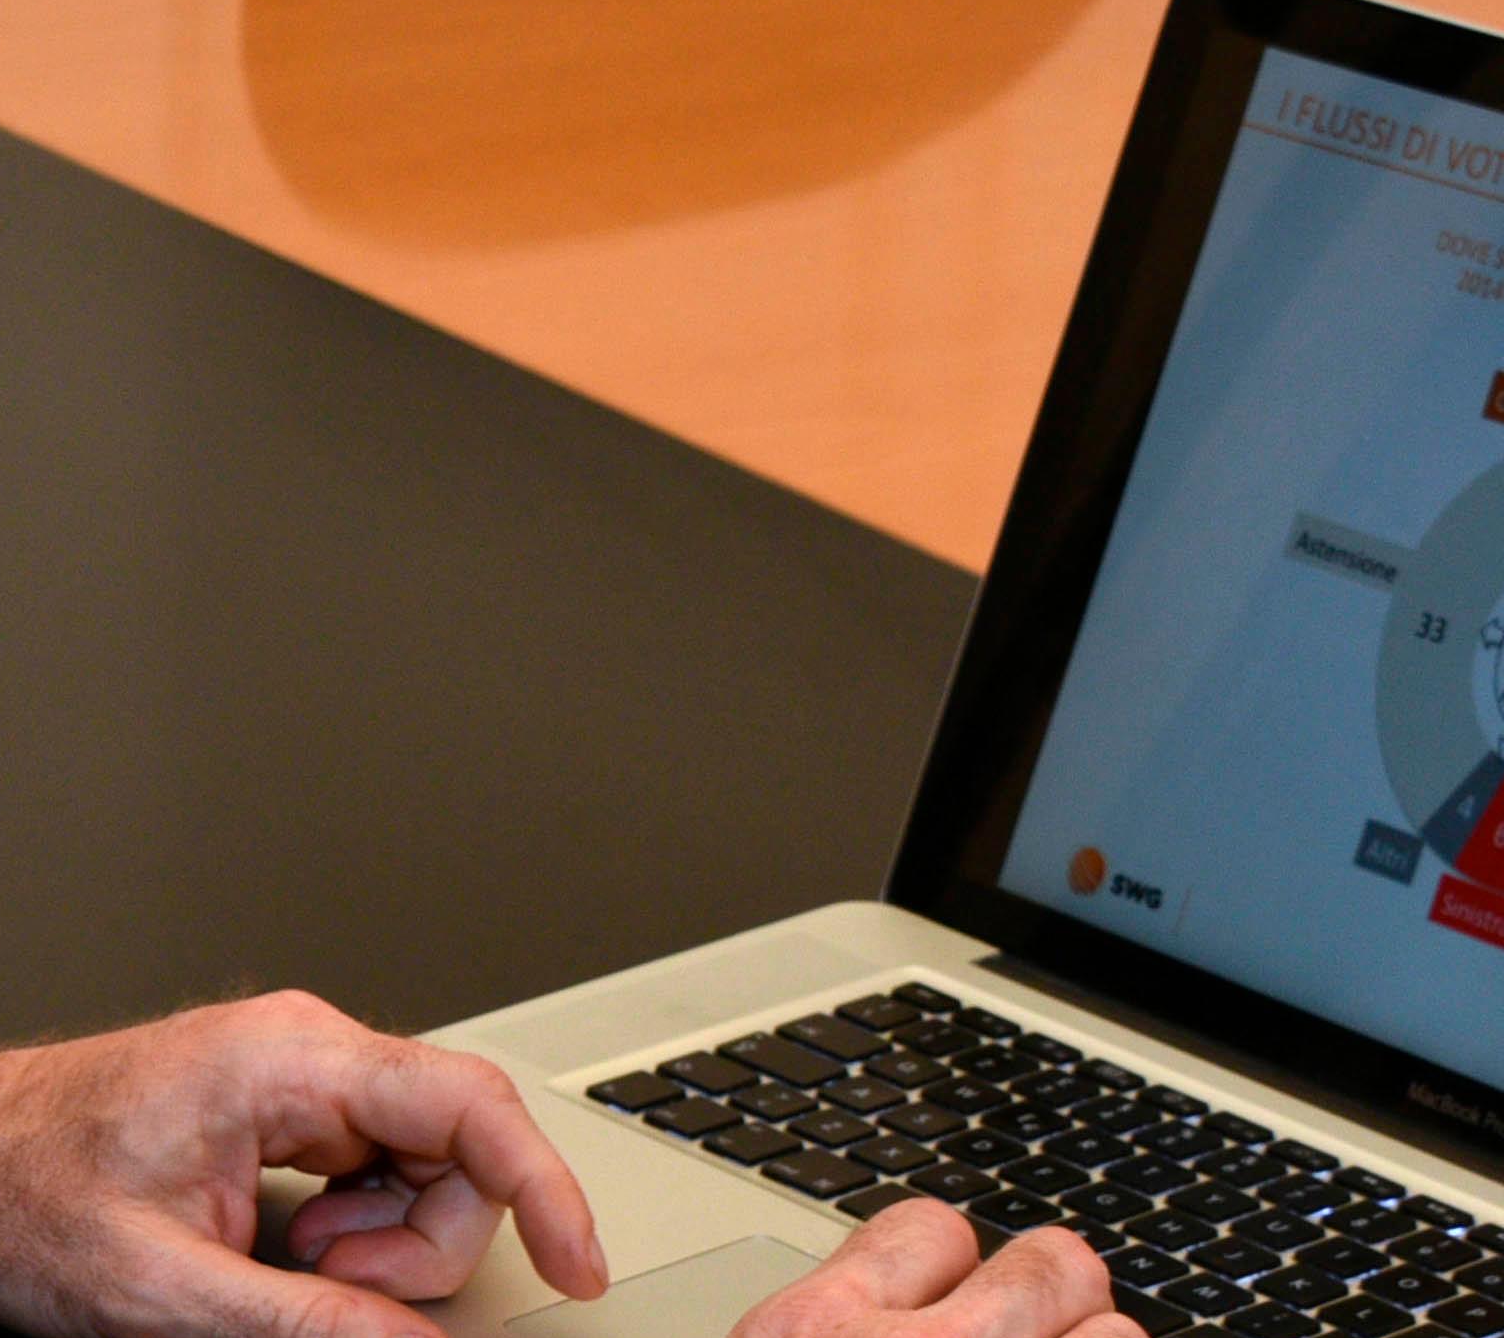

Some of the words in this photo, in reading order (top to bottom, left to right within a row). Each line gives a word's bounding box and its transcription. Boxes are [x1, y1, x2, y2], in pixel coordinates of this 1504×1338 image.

[1277, 91, 1292, 121] I
[1295, 92, 1397, 152] FLUSSI
[1401, 125, 1440, 165] DI
[1436, 228, 1490, 265] DOVE
[1294, 530, 1398, 583] Astensione
[1414, 611, 1449, 647] 33
[1456, 794, 1477, 821] 4
[1363, 839, 1411, 873] Altri
[1407, 1081, 1481, 1125] MacBook
